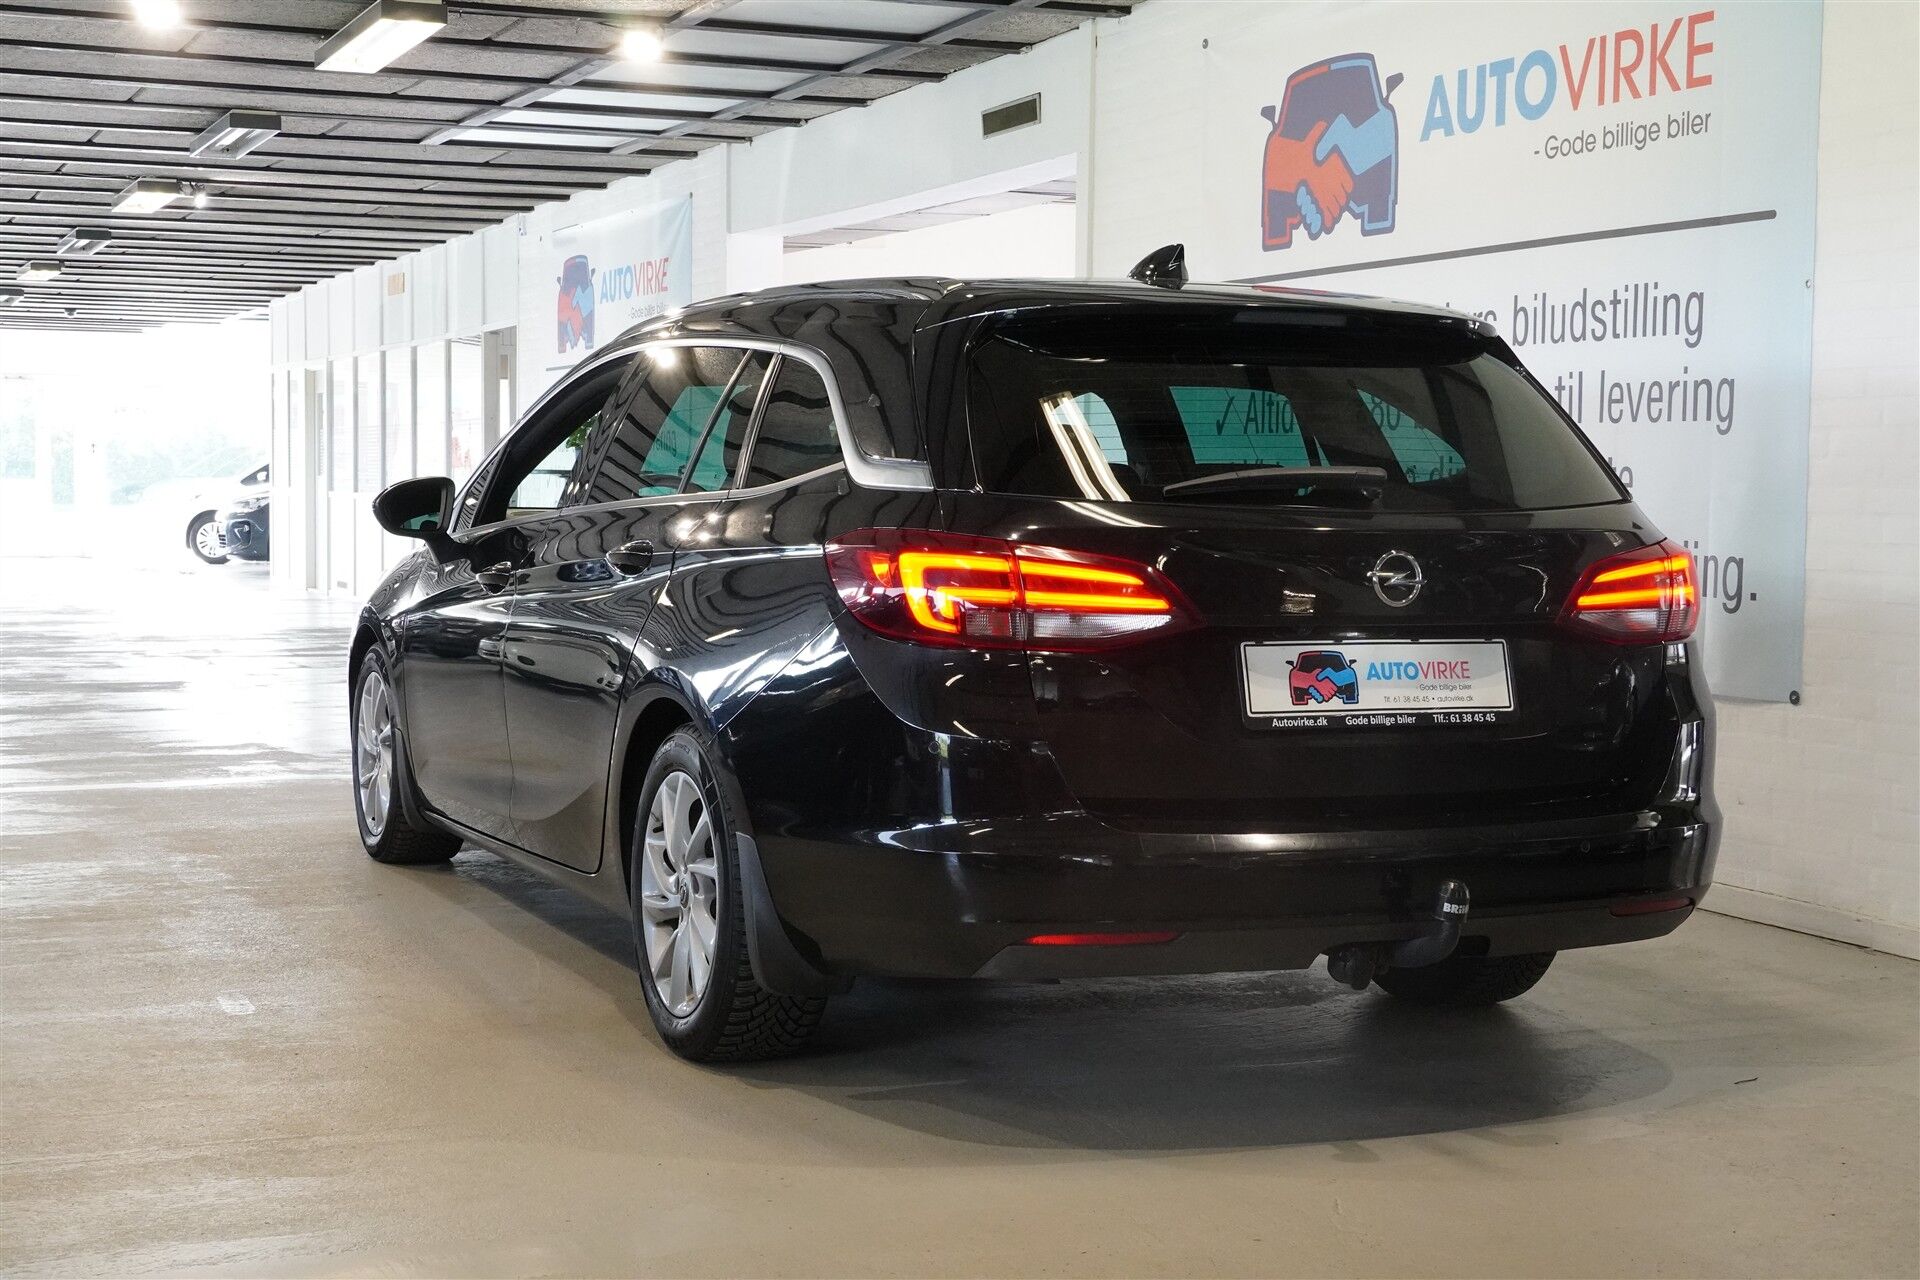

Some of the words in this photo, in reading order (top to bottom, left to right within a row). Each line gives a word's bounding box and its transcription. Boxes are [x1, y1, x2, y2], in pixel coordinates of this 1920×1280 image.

[1420, 10, 1714, 142] AUTOVIRKE
[1545, 130, 1597, 159] Gode
[1602, 121, 1660, 150] billige
[1667, 111, 1711, 138] biler
[600, 257, 669, 304] AUTOVIRKE
[1512, 282, 1704, 348] biludstilling
[1554, 371, 1583, 423] til
[1599, 366, 1735, 435] levering
[1367, 661, 1470, 680] AUTOVIRKE
[1420, 683, 1438, 691] Gode
[1272, 717, 1328, 727] Autovirke.dk
[1345, 716, 1369, 725] Gode
[1370, 715, 1395, 726] billige
[1397, 714, 1416, 724] biler
[1433, 714, 1448, 723] Tlf.:
[1450, 714, 1460, 723] 61
[1462, 714, 1472, 723] 38
[1474, 713, 1484, 722] 45
[1485, 713, 1496, 722] 45
[1403, 695, 1411, 703] 38
